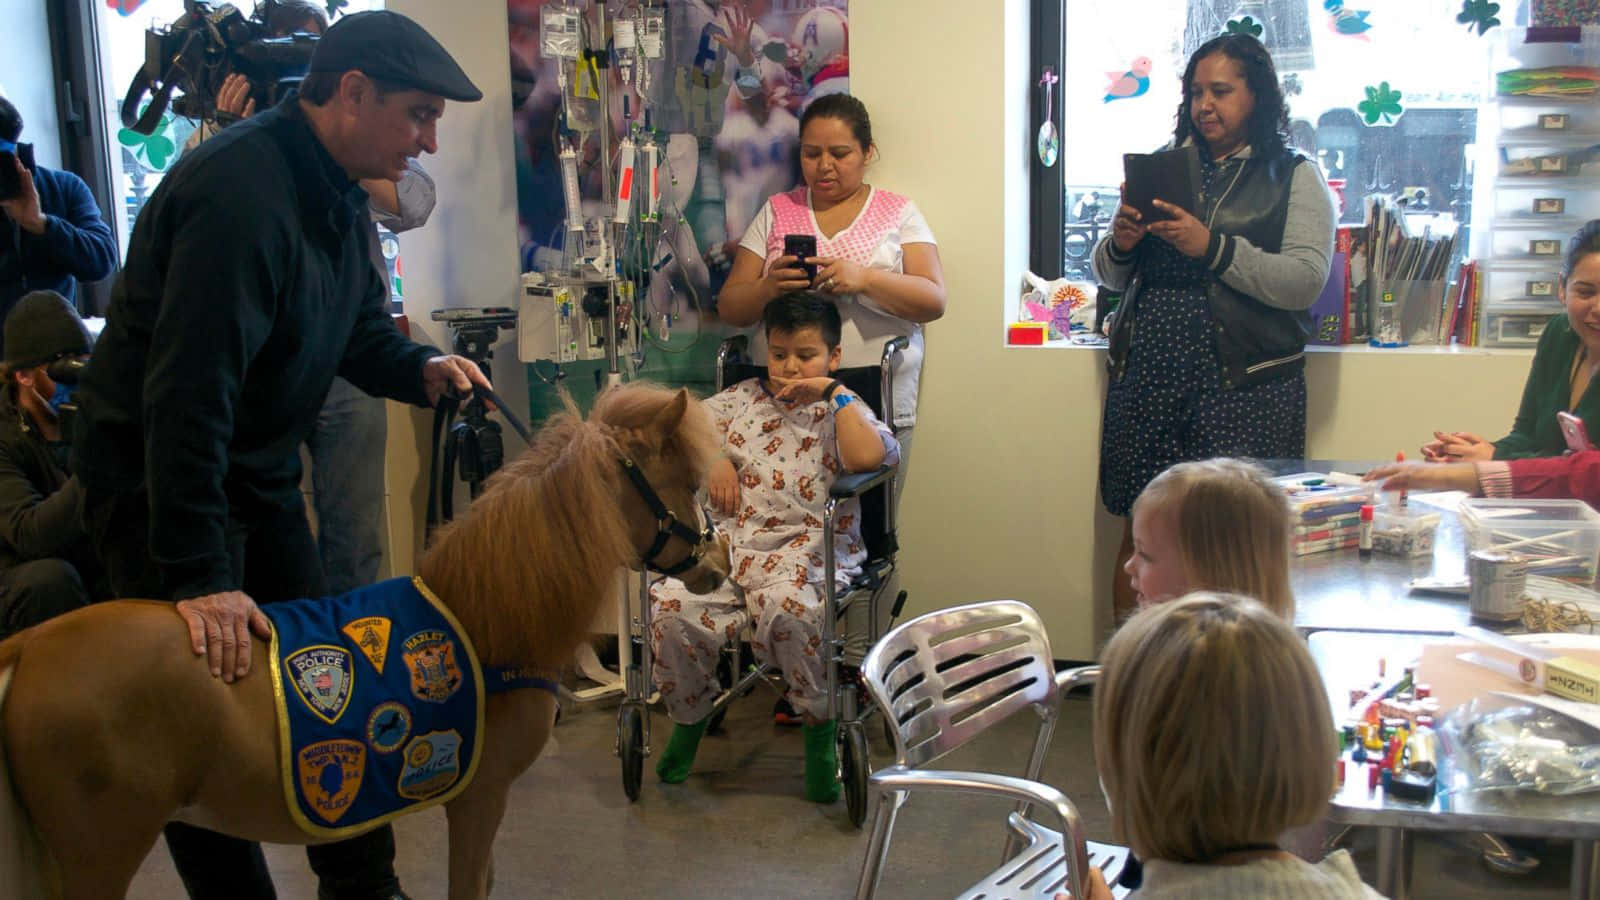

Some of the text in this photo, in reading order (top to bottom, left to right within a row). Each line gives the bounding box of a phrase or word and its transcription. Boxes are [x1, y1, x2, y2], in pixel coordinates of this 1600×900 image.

[405, 632, 447, 650] HAZLET
[297, 655, 344, 672] POLICE
[304, 743, 361, 760] MIDDLETOWN
[410, 753, 455, 777] POLICE
[316, 793, 350, 808] POLICE
